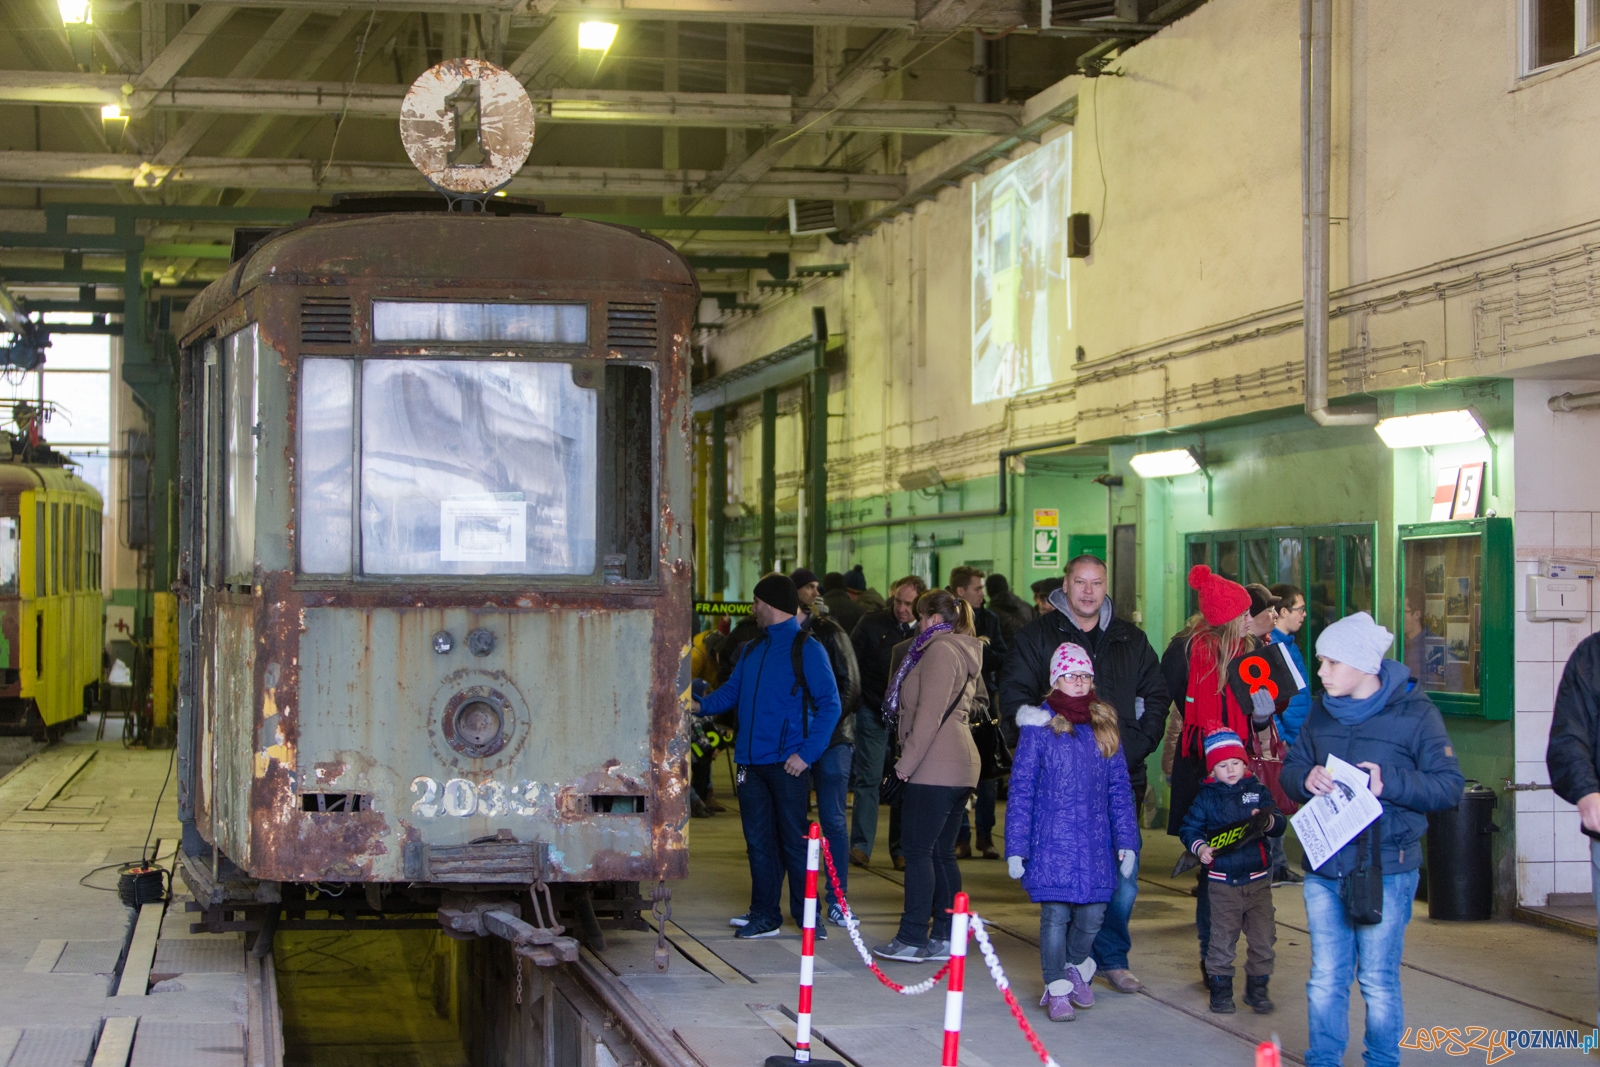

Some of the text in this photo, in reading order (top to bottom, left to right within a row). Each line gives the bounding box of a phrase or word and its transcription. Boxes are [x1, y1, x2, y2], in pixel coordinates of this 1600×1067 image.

[444, 80, 494, 168] 1
[1461, 474, 1474, 507] 5
[1238, 655, 1279, 701] 8
